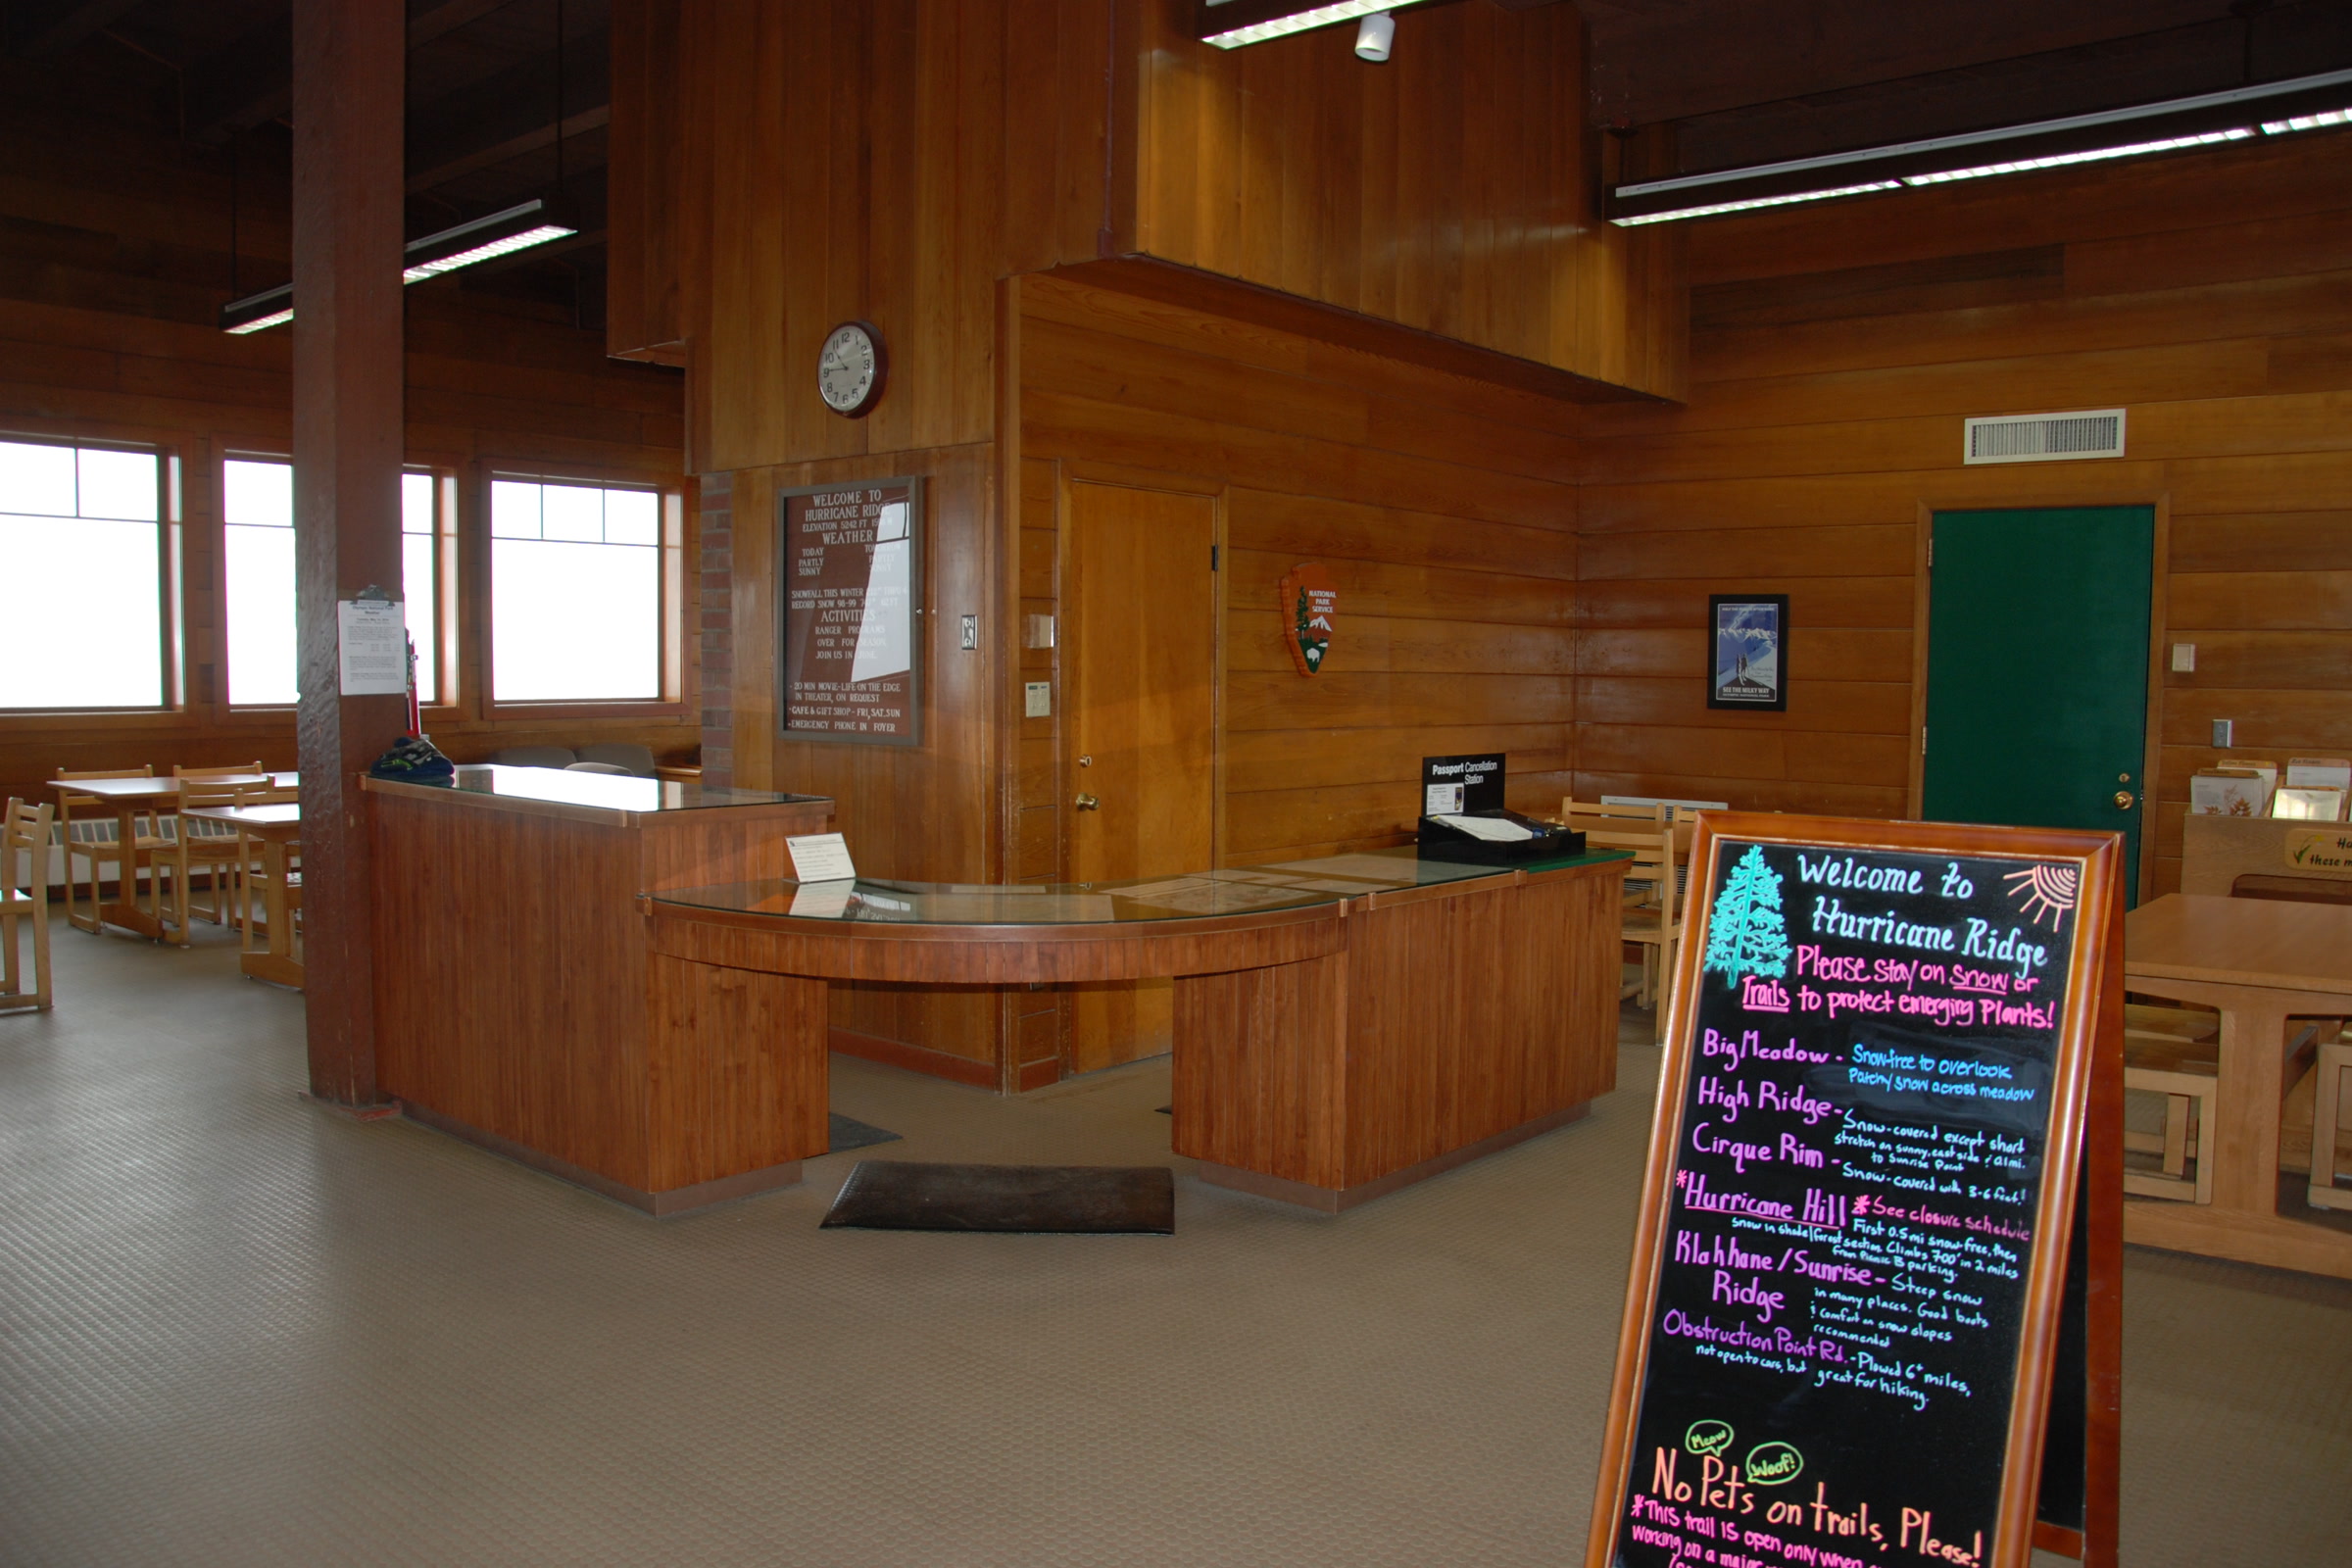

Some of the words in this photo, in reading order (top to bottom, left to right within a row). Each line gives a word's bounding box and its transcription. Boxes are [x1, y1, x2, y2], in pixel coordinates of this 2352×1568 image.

[832, 338, 839, 350] 11
[841, 331, 850, 343] 12
[855, 334, 858, 345] 1
[825, 352, 834, 363] 10
[860, 345, 867, 356] 2
[862, 359, 870, 369] 3
[823, 368, 830, 378] 9
[859, 375, 866, 386] 4
[826, 382, 833, 393] 8
[851, 388, 858, 399] 5
[833, 392, 839, 403] 7
[843, 394, 849, 404] 6
[812, 491, 862, 508] WELCOME
[868, 489, 882, 502] TO
[805, 505, 858, 522] HURRICANE
[802, 521, 838, 533] ELEVATION
[858, 518, 867, 528] FT
[822, 530, 873, 545] WEATHER
[802, 547, 824, 558] TODAY
[798, 558, 824, 567] PARTLY
[798, 566, 821, 576] SUNNY
[791, 589, 823, 599] SNOWFALL
[823, 588, 838, 597] THIS
[840, 588, 863, 597] WINTER
[791, 600, 815, 610] RECORD
[817, 599, 835, 609] SNOW
[821, 609, 876, 623] ACTIVITIES
[814, 625, 842, 635] RANGER
[804, 682, 816, 691] MIN
[857, 683, 866, 692] ON
[867, 683, 881, 692] THE
[883, 684, 901, 693] EDGE
[791, 707, 808, 715] CAFE
[809, 707, 815, 715] &
[815, 708, 832, 716] GIFT
[791, 720, 830, 730] EMERGENCY
[834, 721, 857, 731] PHONE
[859, 722, 867, 731] IN
[873, 723, 896, 733] FOYER
[1433, 763, 1464, 775] Passport
[1465, 761, 1497, 772] Cancellation
[1465, 774, 1484, 784] Station
[2309, 854, 2340, 866] these
[1796, 854, 1924, 894] Welcome
[1940, 861, 1974, 899] to
[1812, 895, 1955, 953] Hurricane
[1961, 917, 2048, 979] Ridge
[1796, 944, 1872, 983] Please
[1873, 958, 1919, 992] stay
[1919, 964, 1945, 986] on
[2013, 978, 2039, 992] or
[1741, 974, 1790, 1007] Trails
[1796, 984, 1822, 1012] to
[1826, 989, 1895, 1019] protect
[1897, 993, 1975, 1026] emerging
[1978, 998, 2056, 1030] Plants!
[1701, 1027, 1739, 1072] Big
[1740, 1029, 1831, 1064] Meadow
[1918, 1054, 1936, 1072] to
[1937, 1059, 2014, 1080] overlook
[1893, 1075, 1930, 1092] snow
[1932, 1081, 1977, 1097] across
[1979, 1086, 2035, 1102] meadow
[1697, 1075, 1750, 1123] High
[1841, 1107, 1939, 1141] Snow-covered
[1942, 1130, 1986, 1153] except
[1988, 1133, 2026, 1155] short
[1834, 1130, 1877, 1149] stretch
[1878, 1142, 1892, 1152] on
[1932, 1145, 1956, 1158] east
[1692, 1121, 1773, 1174] Cirque
[1779, 1132, 1825, 1169] Rim
[1938, 1178, 1963, 1196] with
[1870, 1152, 1884, 1164] to
[1887, 1152, 1931, 1170] Sunrise
[1935, 1157, 1965, 1173] Point
[1801, 1187, 1847, 1227] Hill
[1908, 1203, 1962, 1229] closure
[1964, 1214, 2032, 1242] schedule
[1852, 1217, 1886, 1236] First
[1887, 1226, 1909, 1241] 0.5
[1908, 1230, 1926, 1245] mi
[1991, 1242, 2019, 1263] then
[1731, 1216, 1763, 1230] snow
[1763, 1222, 1777, 1233] in
[1885, 1240, 1929, 1261] Climbs
[1960, 1257, 1973, 1269] in
[1974, 1259, 1985, 1272] 2
[1985, 1261, 2020, 1280] miles
[1831, 1245, 1857, 1260] from
[1893, 1254, 1906, 1268] B
[1890, 1271, 1937, 1299] Steep
[1941, 1289, 1983, 1306] snow
[1711, 1268, 1787, 1324] Ridge
[1814, 1286, 1828, 1298] in
[1828, 1291, 1864, 1309] many
[1917, 1301, 1949, 1321] Good
[1954, 1307, 1990, 1329] boots
[1819, 1306, 1862, 1323] comfort
[1861, 1317, 1875, 1326] on
[1878, 1320, 1909, 1334] snow
[1910, 1321, 1953, 1343] slopes
[1662, 1308, 1774, 1352] Obstruction
[1773, 1325, 1818, 1357] Point
[1813, 1323, 1891, 1348] recommended
[1694, 1344, 1717, 1356] not
[1716, 1349, 1744, 1365] open
[1743, 1351, 1759, 1365] to
[1786, 1357, 1808, 1373] but
[1813, 1369, 1854, 1388] great
[1853, 1372, 1878, 1389] for
[1690, 1428, 1728, 1449] Meow
[1651, 1446, 1693, 1503] No
[1699, 1454, 1755, 1515] Pets
[1765, 1499, 1803, 1527] on
[1809, 1480, 1890, 1552] trails,
[1899, 1506, 1984, 1568] Please!
[1684, 1509, 1715, 1539] trail
[1743, 1530, 1782, 1552] open
[1783, 1543, 1819, 1567] only
[1683, 1541, 1702, 1560] on
[1704, 1548, 1716, 1564] a
